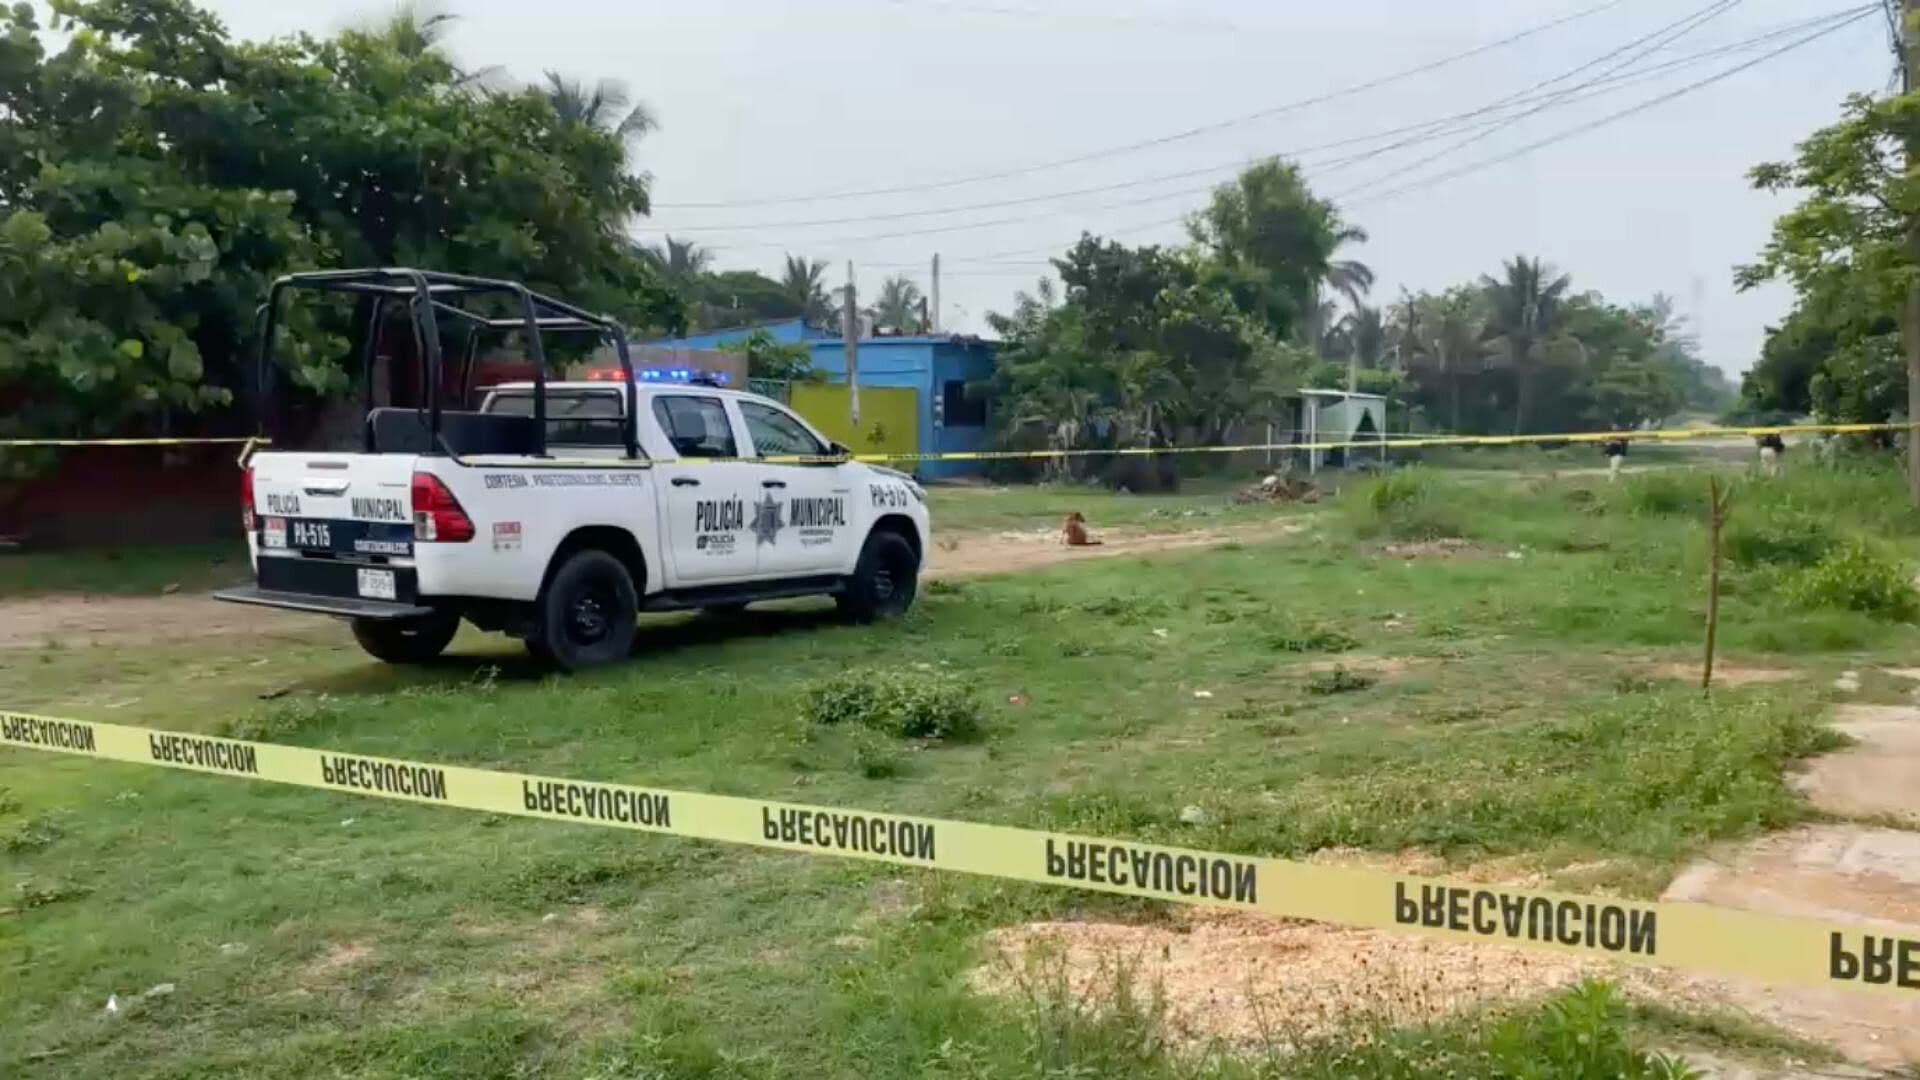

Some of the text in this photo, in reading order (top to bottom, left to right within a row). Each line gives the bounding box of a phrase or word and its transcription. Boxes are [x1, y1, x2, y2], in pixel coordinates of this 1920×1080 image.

[351, 497, 406, 521] MUNICIPAL
[695, 493, 845, 532] POLICÍA MUNICIPAL
[294, 522, 331, 547] PA-515
